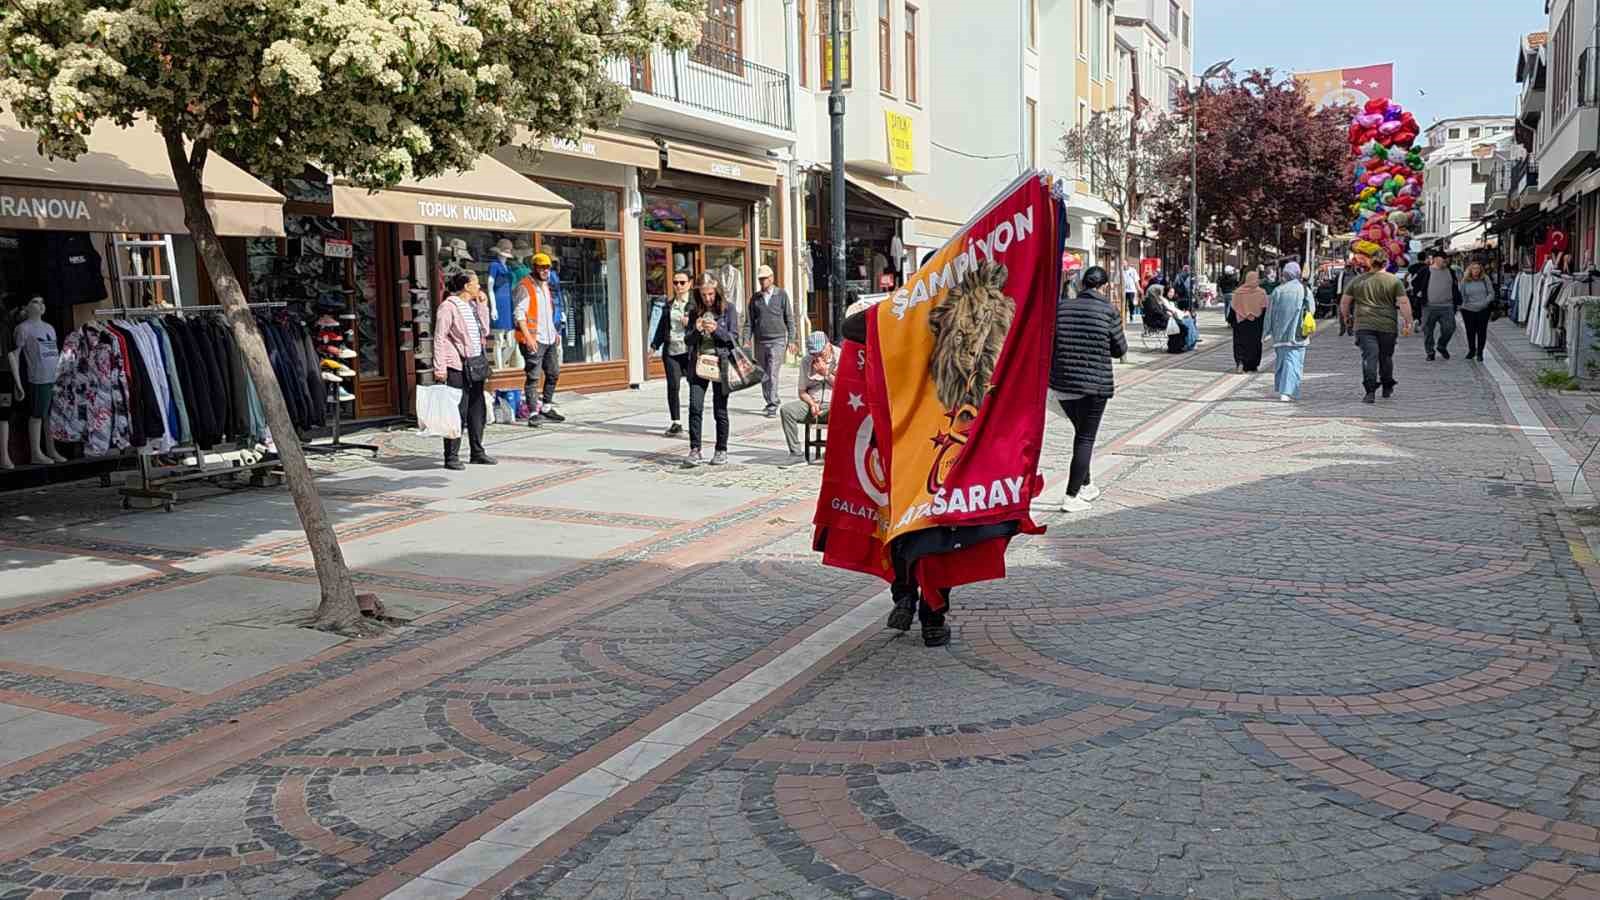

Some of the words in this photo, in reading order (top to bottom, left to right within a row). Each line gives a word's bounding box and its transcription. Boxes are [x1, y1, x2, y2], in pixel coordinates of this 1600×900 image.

[418, 201, 458, 219] TOPUK
[463, 205, 517, 223] KUNDURA
[890, 205, 1034, 320] ŞAMPİYON
